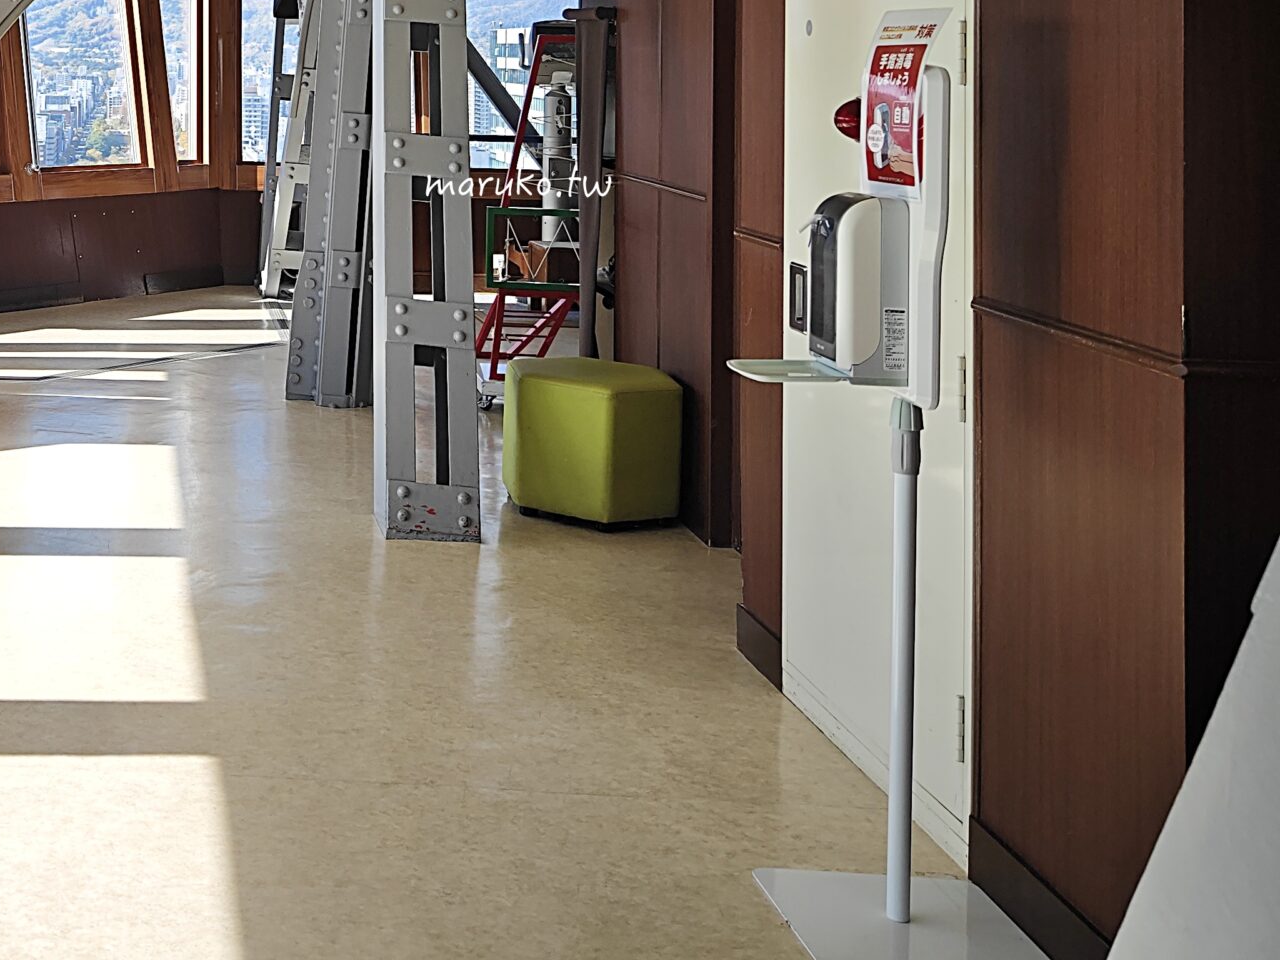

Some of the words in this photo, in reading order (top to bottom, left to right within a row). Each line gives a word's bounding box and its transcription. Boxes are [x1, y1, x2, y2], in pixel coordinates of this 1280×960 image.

[879, 53, 914, 70] 手指消毒
[876, 72, 909, 86] しましょう
[893, 106, 910, 124] 自動
